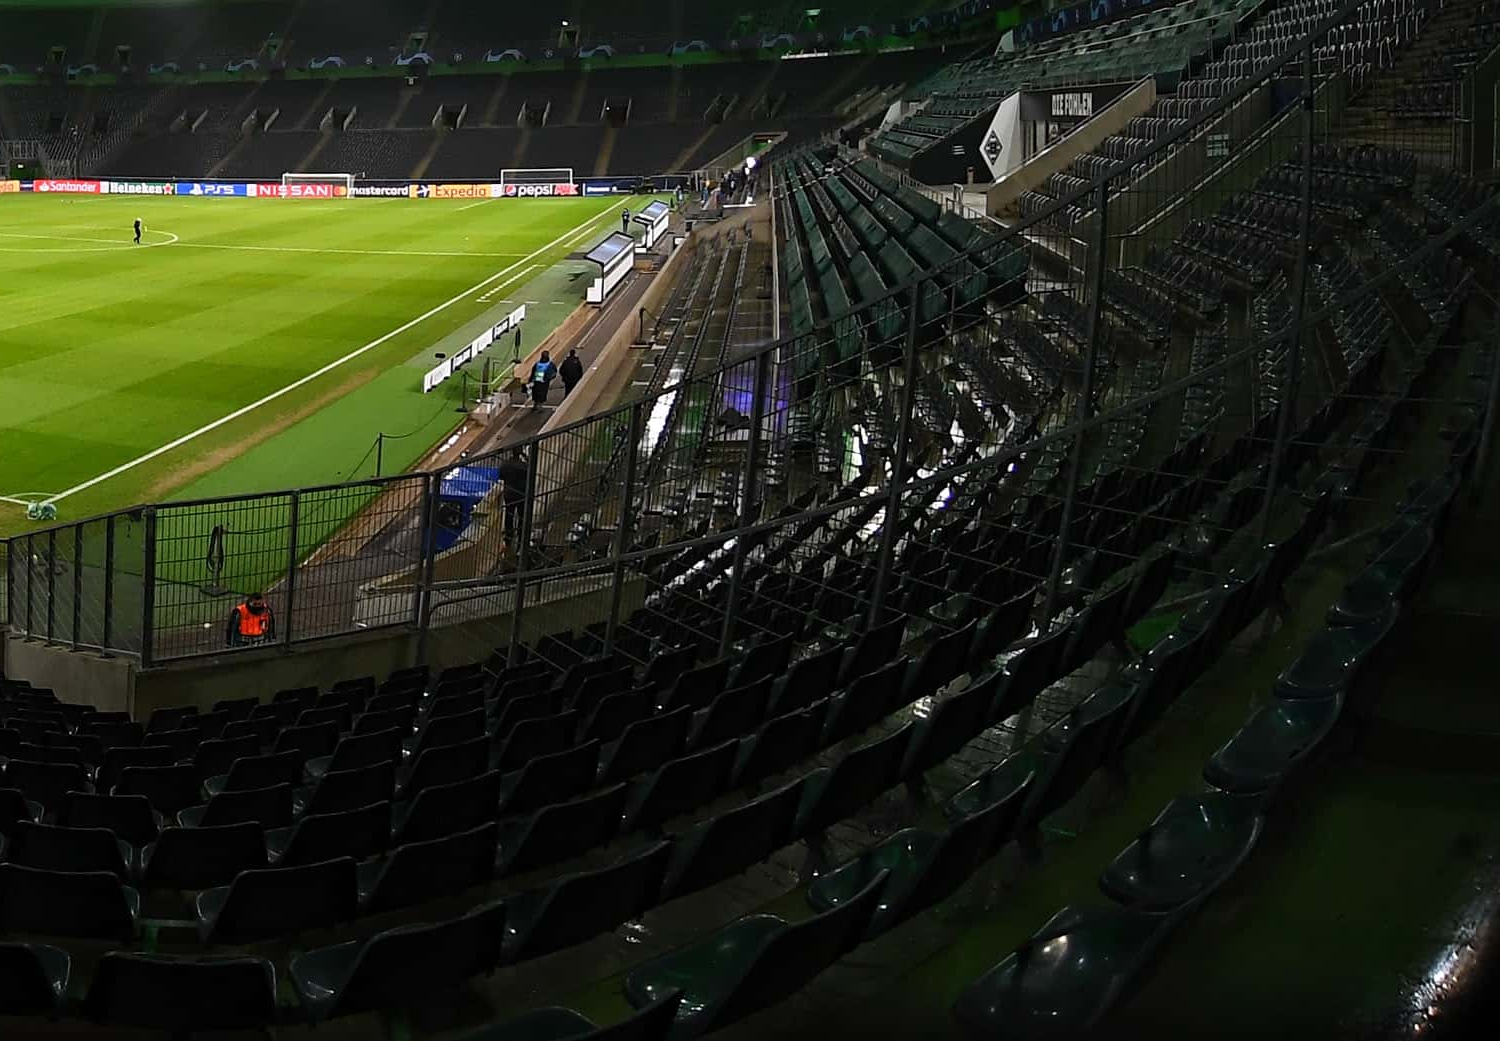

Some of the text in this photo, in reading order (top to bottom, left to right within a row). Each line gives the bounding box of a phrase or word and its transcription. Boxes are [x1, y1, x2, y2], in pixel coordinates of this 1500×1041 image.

[1051, 93, 1064, 116] DIE
[49, 181, 97, 192] Santander
[109, 181, 163, 195] Heineken
[259, 184, 329, 197] NISSAN
[350, 185, 409, 197] mastercard
[435, 185, 487, 198] Expedia
[518, 183, 553, 198] pepsi
